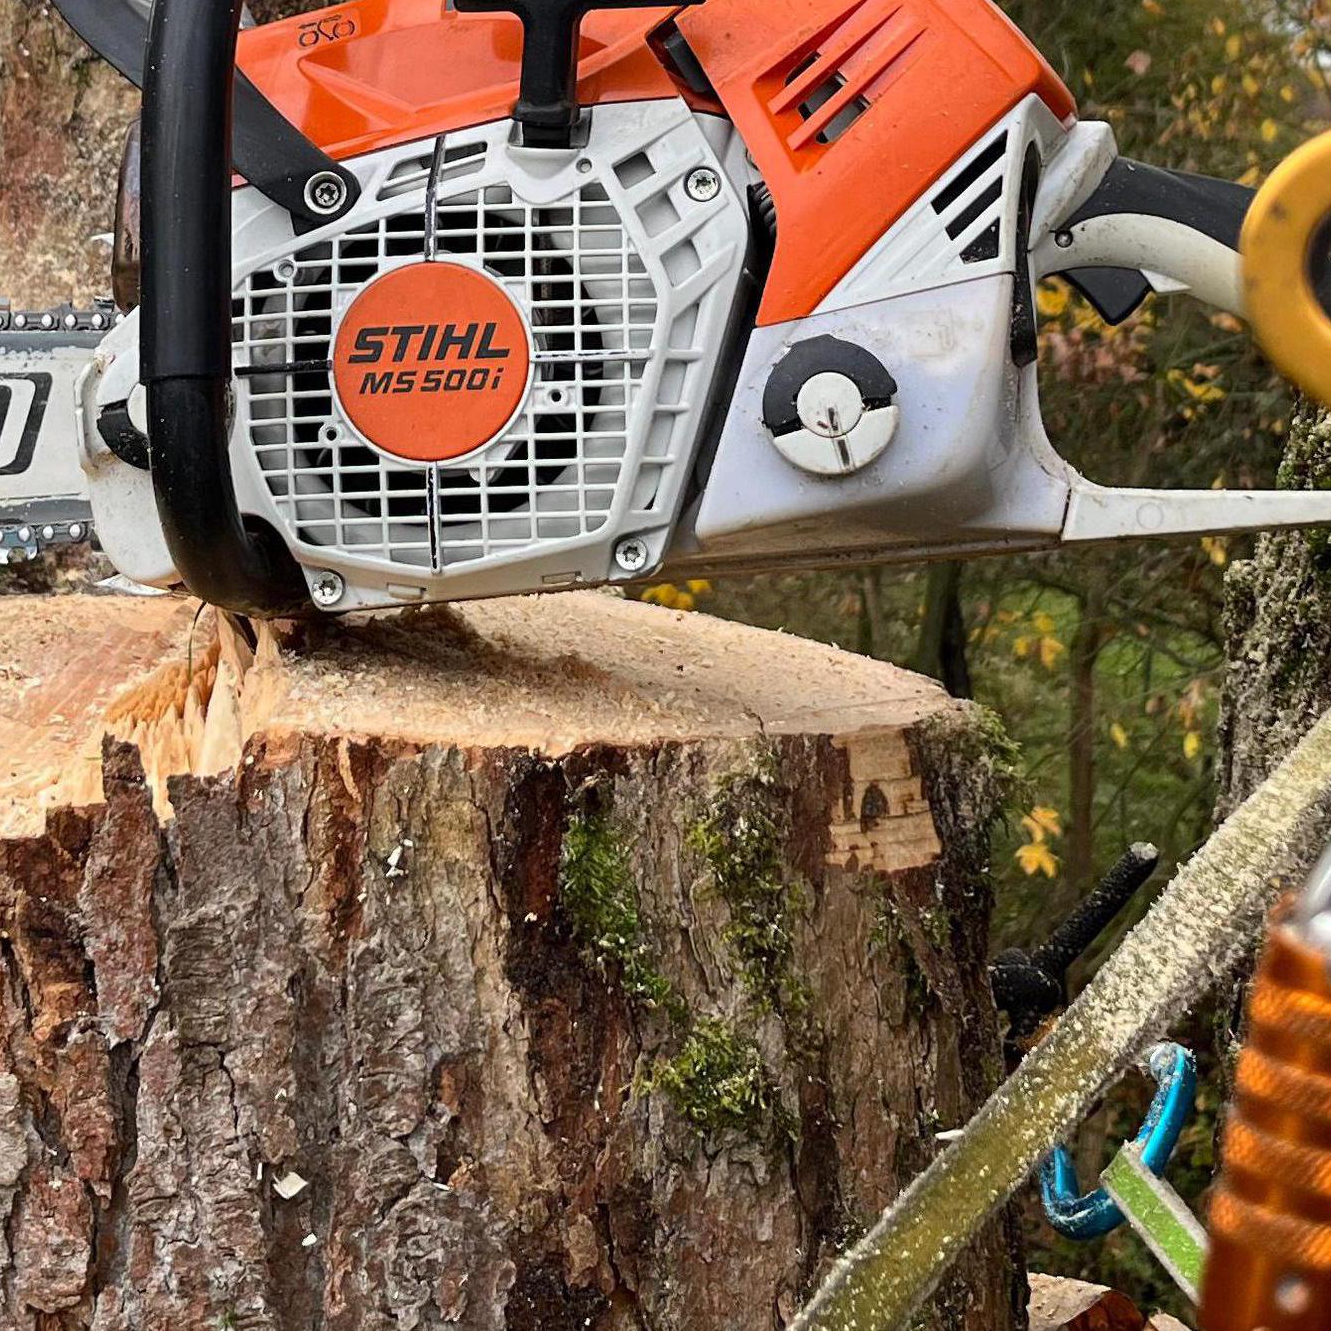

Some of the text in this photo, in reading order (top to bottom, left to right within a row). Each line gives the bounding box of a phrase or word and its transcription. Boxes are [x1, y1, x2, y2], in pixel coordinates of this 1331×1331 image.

[348, 322, 510, 364] STIHL
[359, 367, 504, 394] MS 500i
